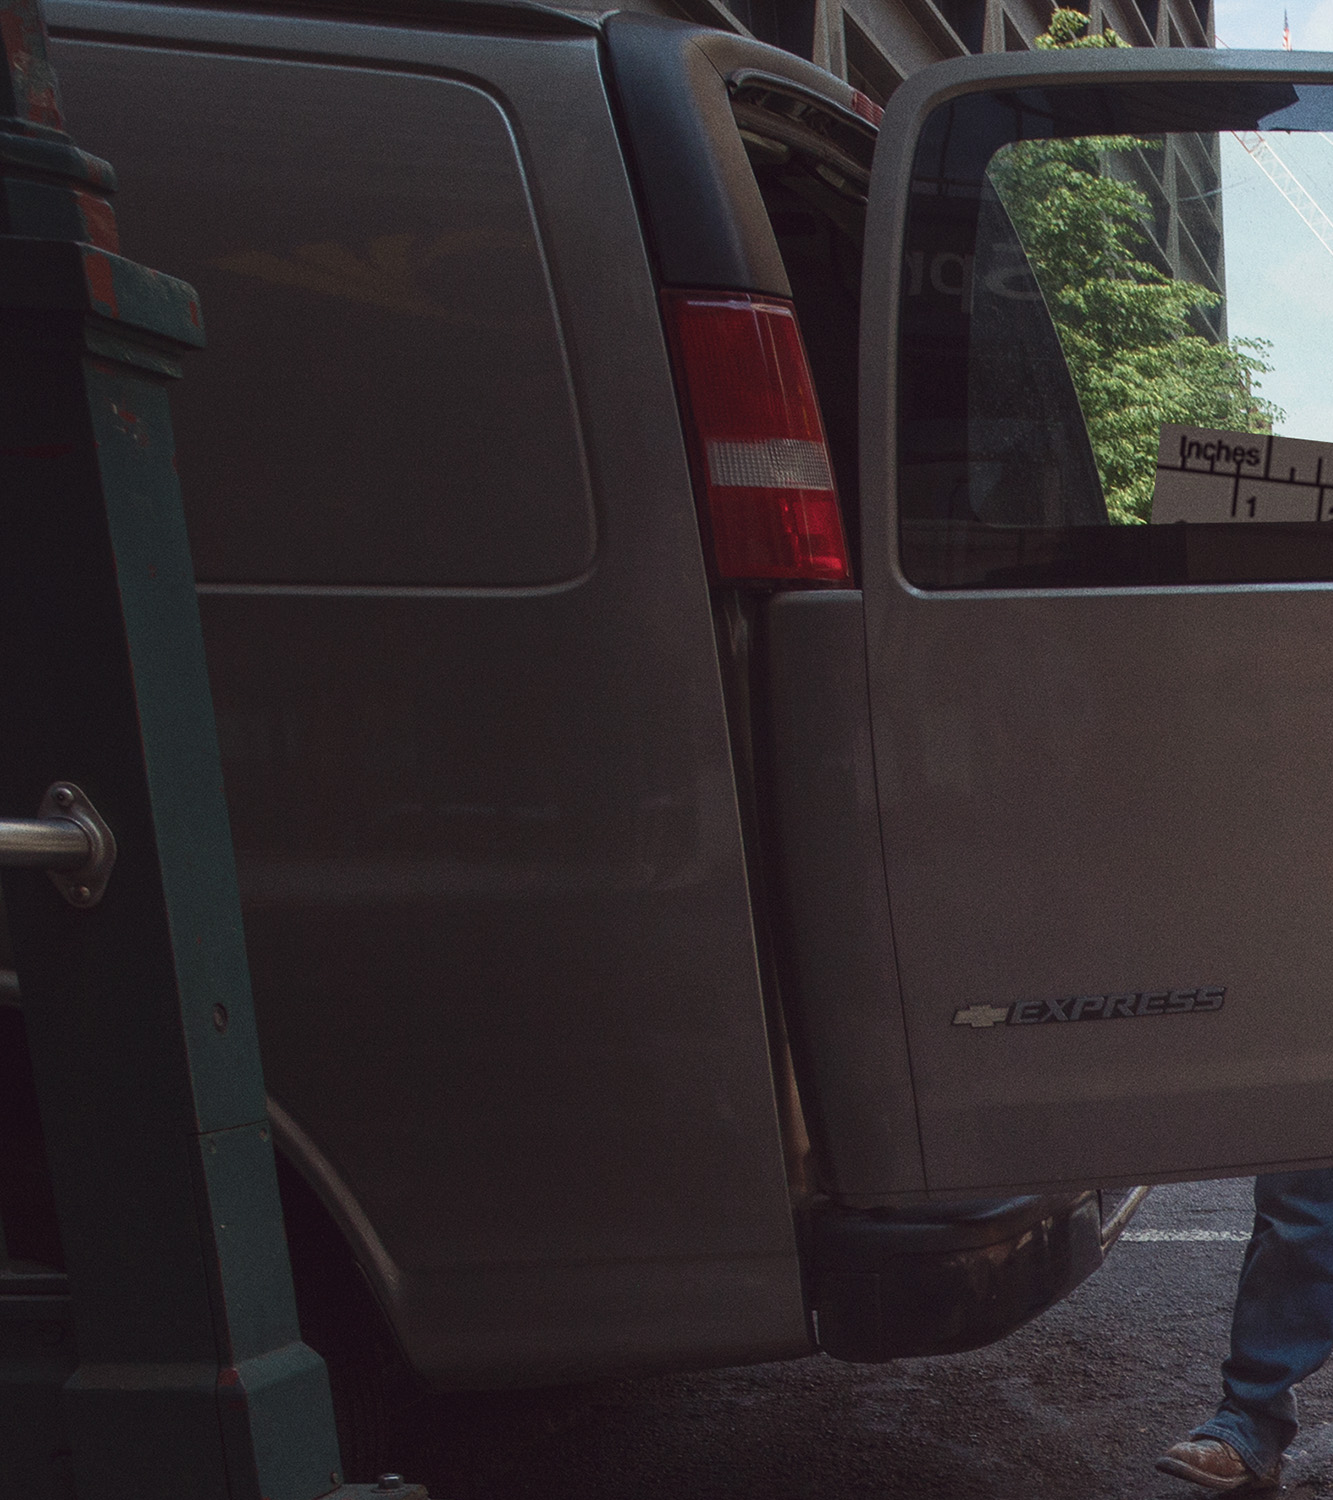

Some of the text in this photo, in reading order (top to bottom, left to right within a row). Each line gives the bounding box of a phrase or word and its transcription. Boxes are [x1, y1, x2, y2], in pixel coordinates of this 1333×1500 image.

[1179, 435, 1260, 467] Inches
[1246, 496, 1257, 518] 1
[1011, 987, 1224, 1025] EXPRESS
